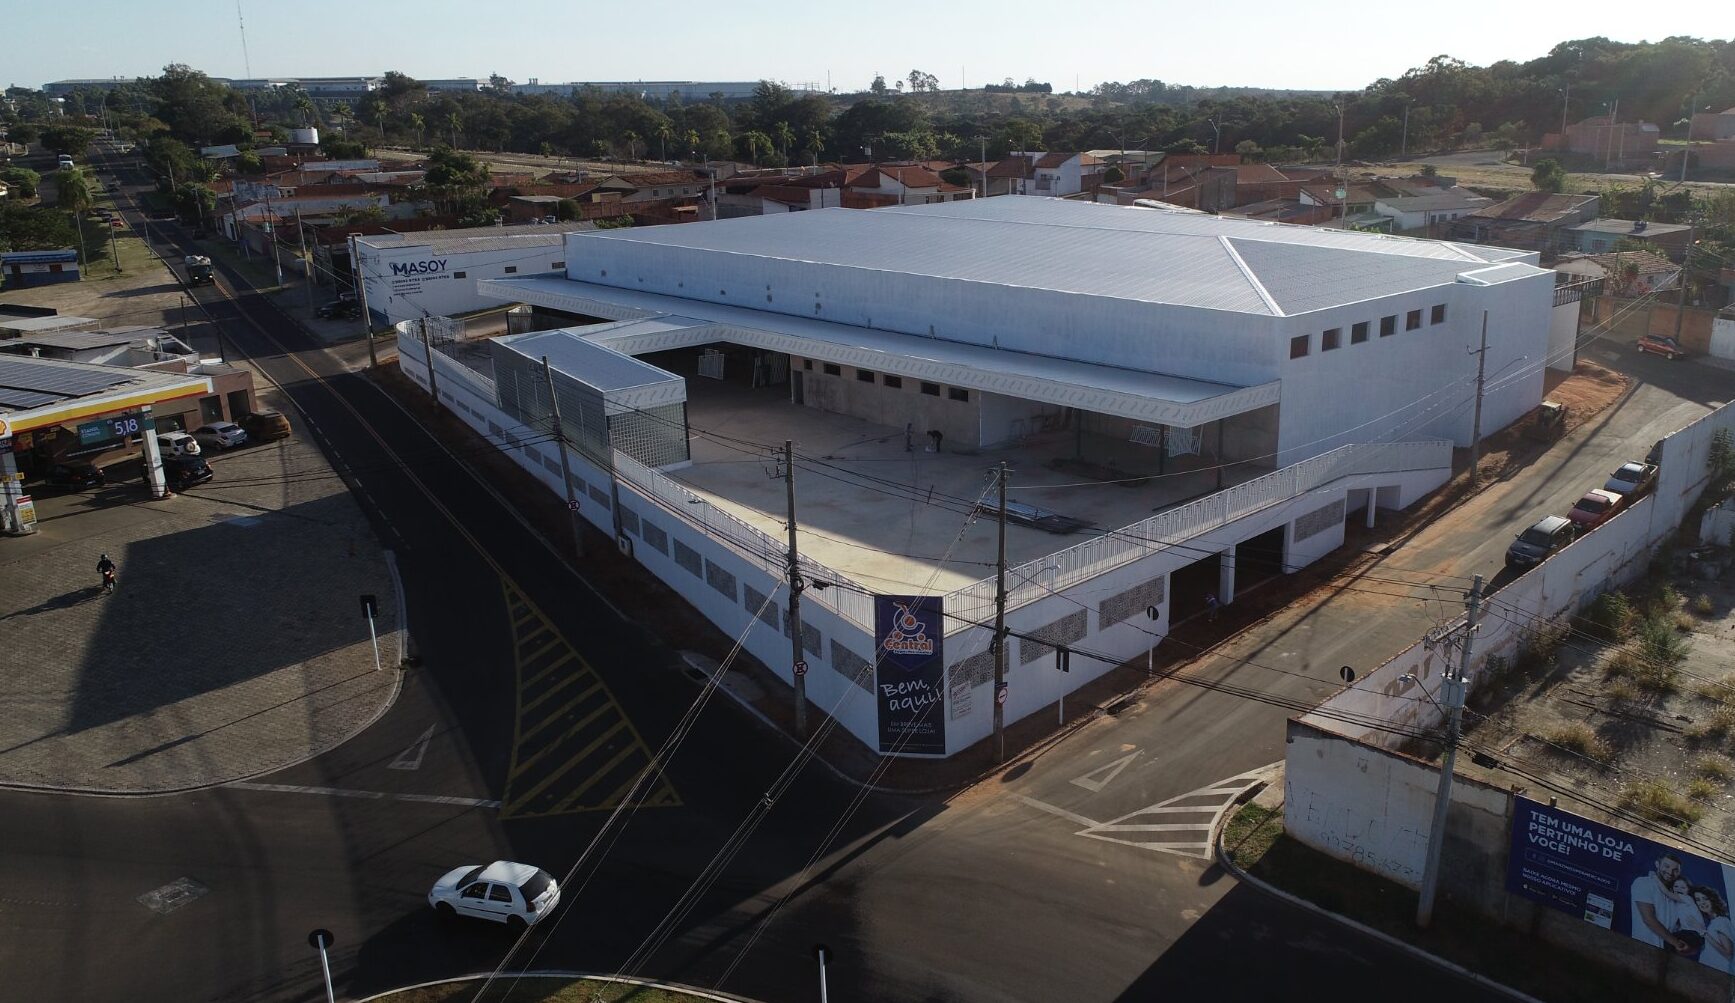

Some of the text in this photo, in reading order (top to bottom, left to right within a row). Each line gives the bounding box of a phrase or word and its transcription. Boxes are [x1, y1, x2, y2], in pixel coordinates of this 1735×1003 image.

[392, 259, 448, 276] MASOY
[114, 418, 138, 436] 5,18
[884, 638, 934, 651] Central
[1530, 810, 1635, 855] TEM UMA LOJA
[1529, 822, 1623, 862] PERTINHO DE
